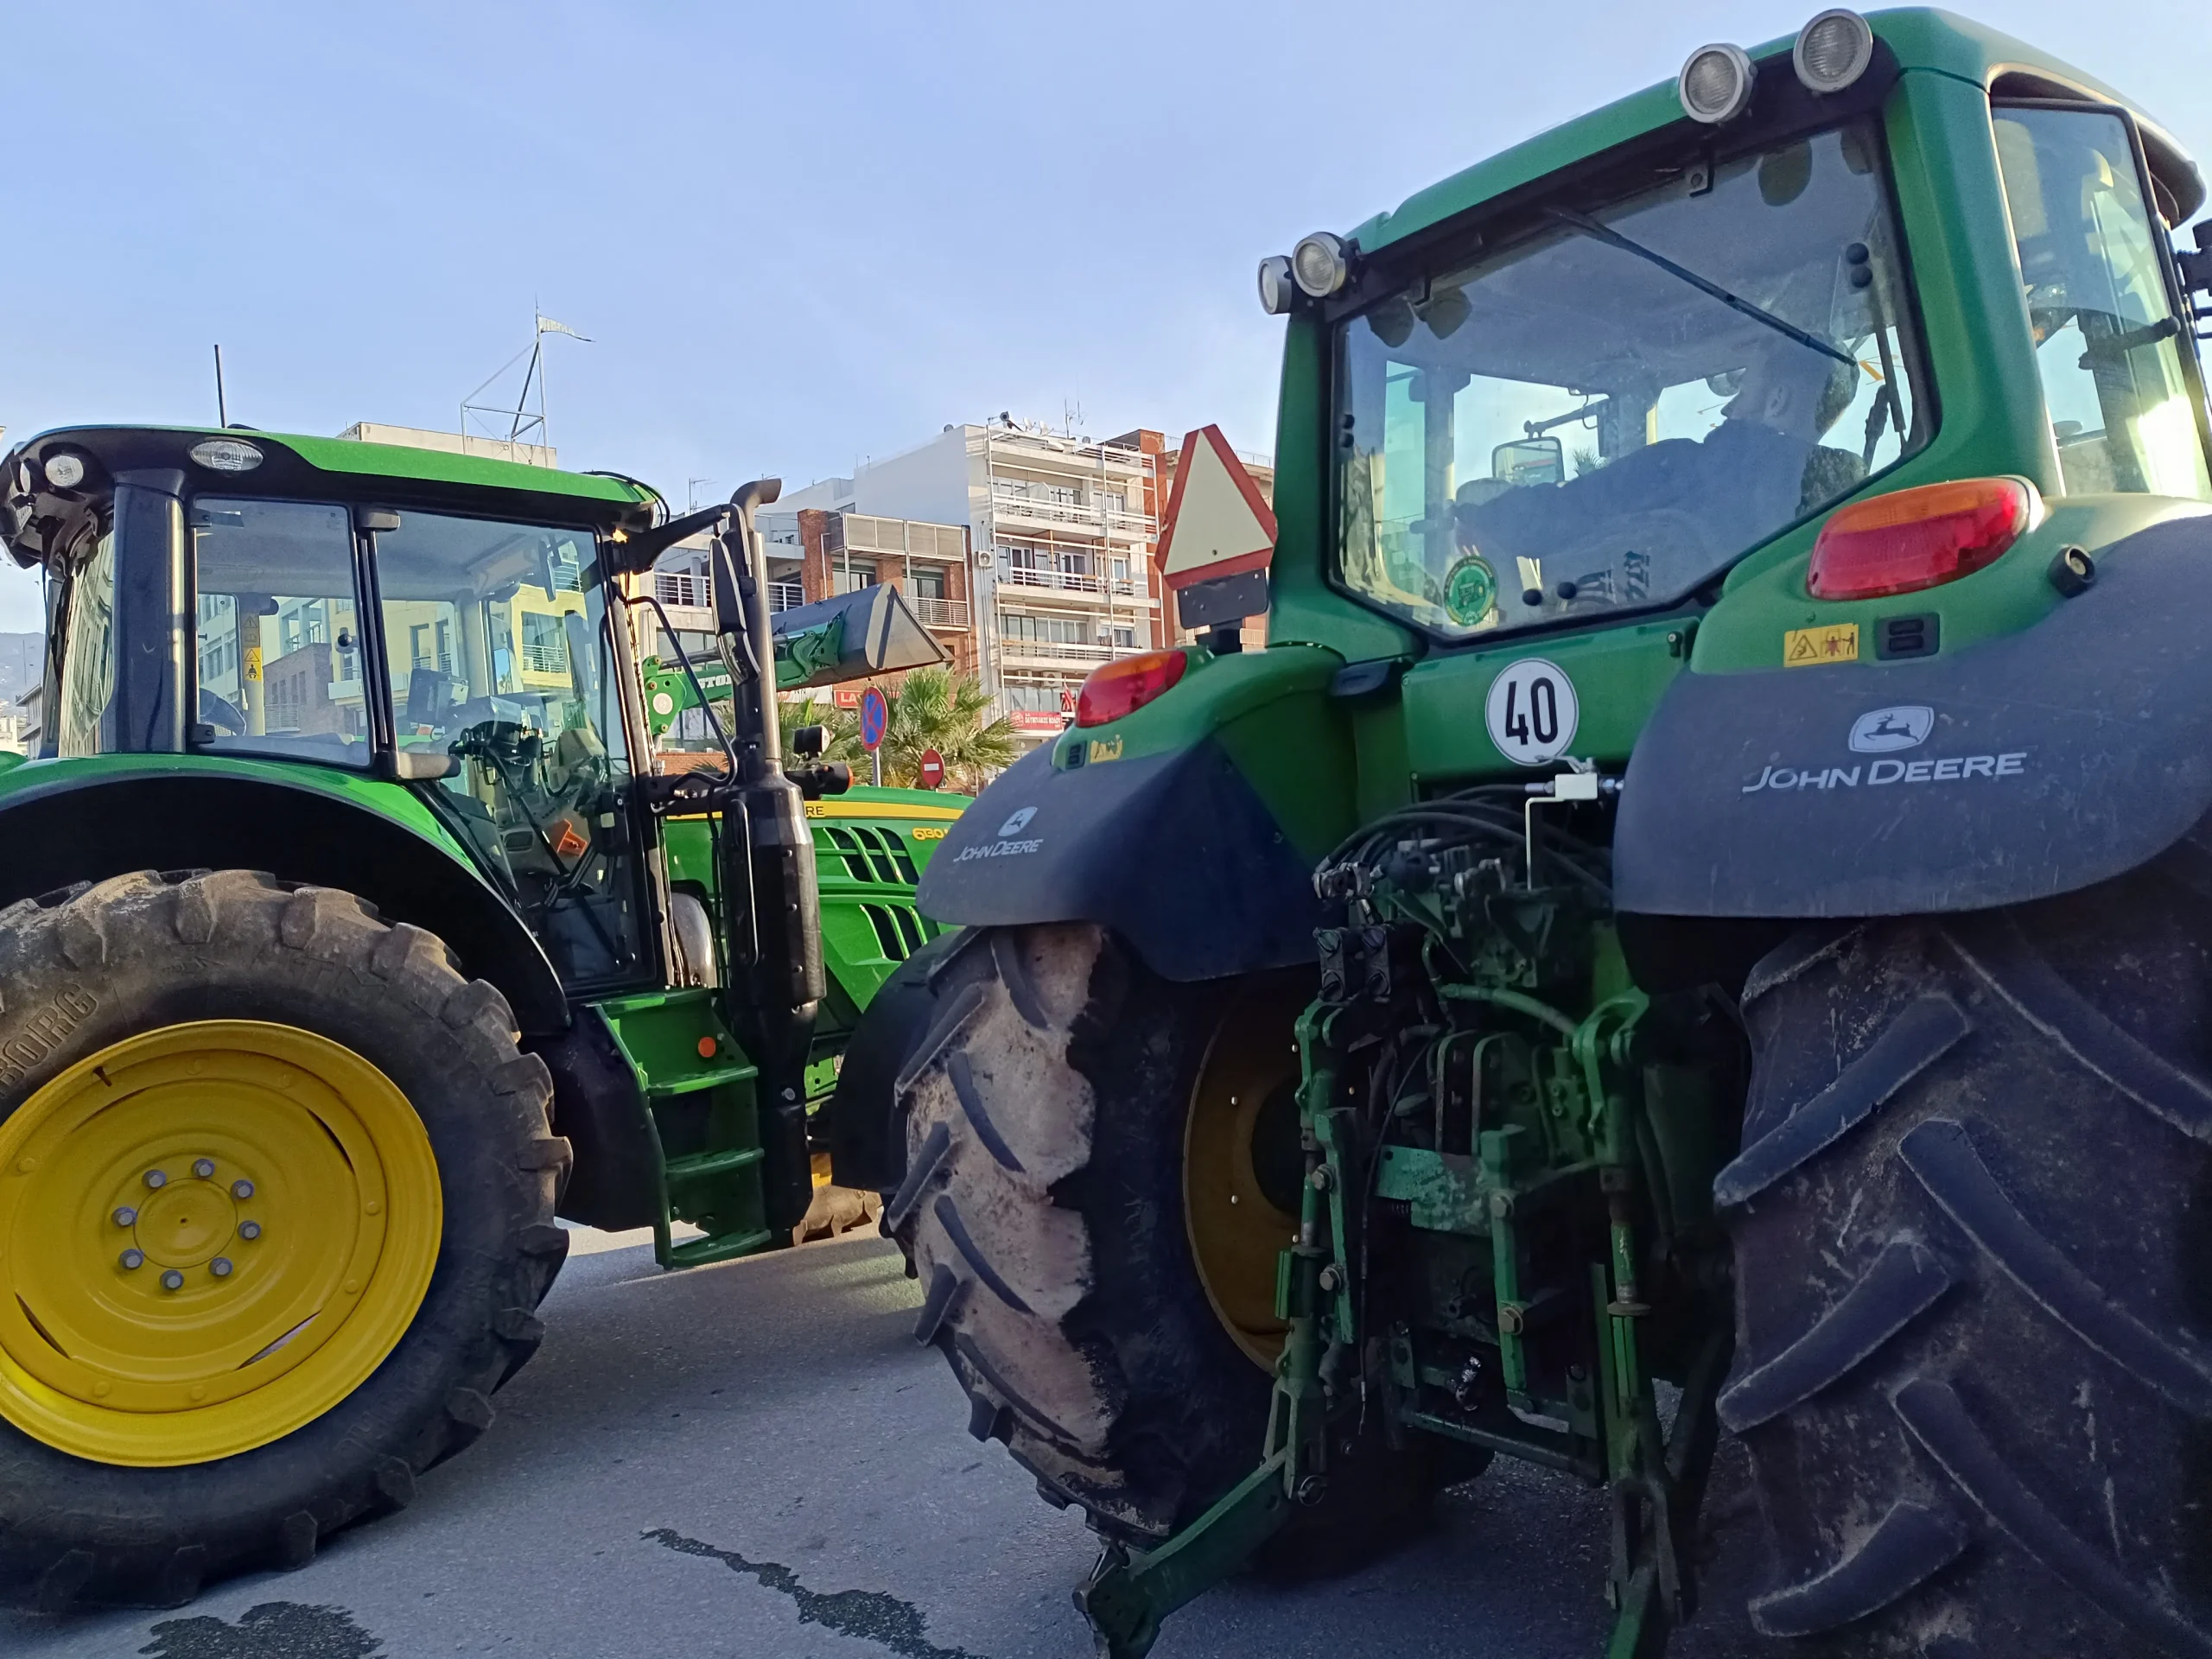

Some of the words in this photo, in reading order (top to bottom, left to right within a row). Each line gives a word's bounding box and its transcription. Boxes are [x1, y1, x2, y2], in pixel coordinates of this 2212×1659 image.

[1505, 677, 1558, 746] 40
[1742, 766, 1861, 794] JOHN
[1867, 753, 2028, 785] DEERE
[953, 844, 994, 862] JOHN
[990, 839, 1044, 857] DEERE
